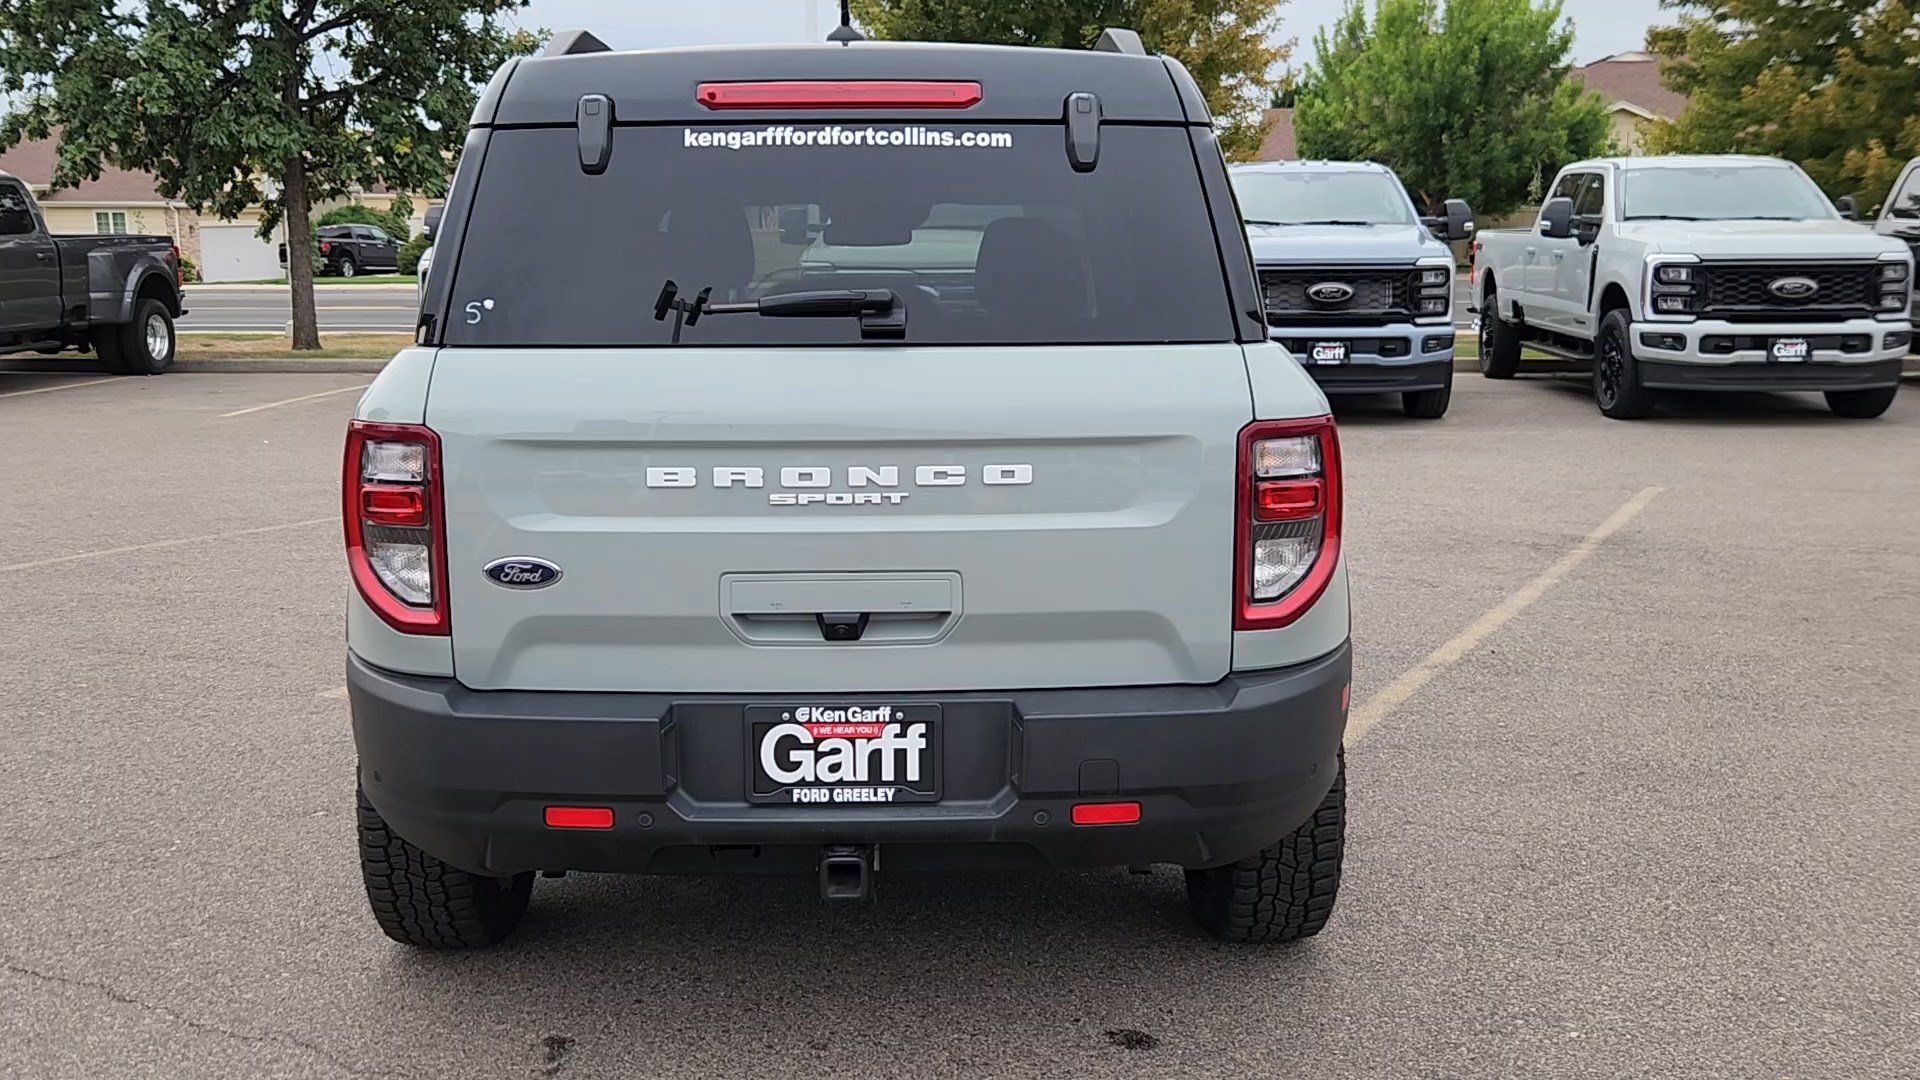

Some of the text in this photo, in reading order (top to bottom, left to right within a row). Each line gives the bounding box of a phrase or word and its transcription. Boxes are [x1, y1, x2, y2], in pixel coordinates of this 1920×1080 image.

[683, 126, 1013, 150] kengarfffordfortcollins.com
[1312, 347, 1346, 360] Garff
[645, 464, 1034, 488] BRONCO
[769, 492, 909, 506] SPORT
[500, 563, 543, 583] Ford
[811, 706, 892, 723] Ken Garff
[760, 723, 927, 784] Garff
[792, 787, 896, 803] FORD GREELEY
